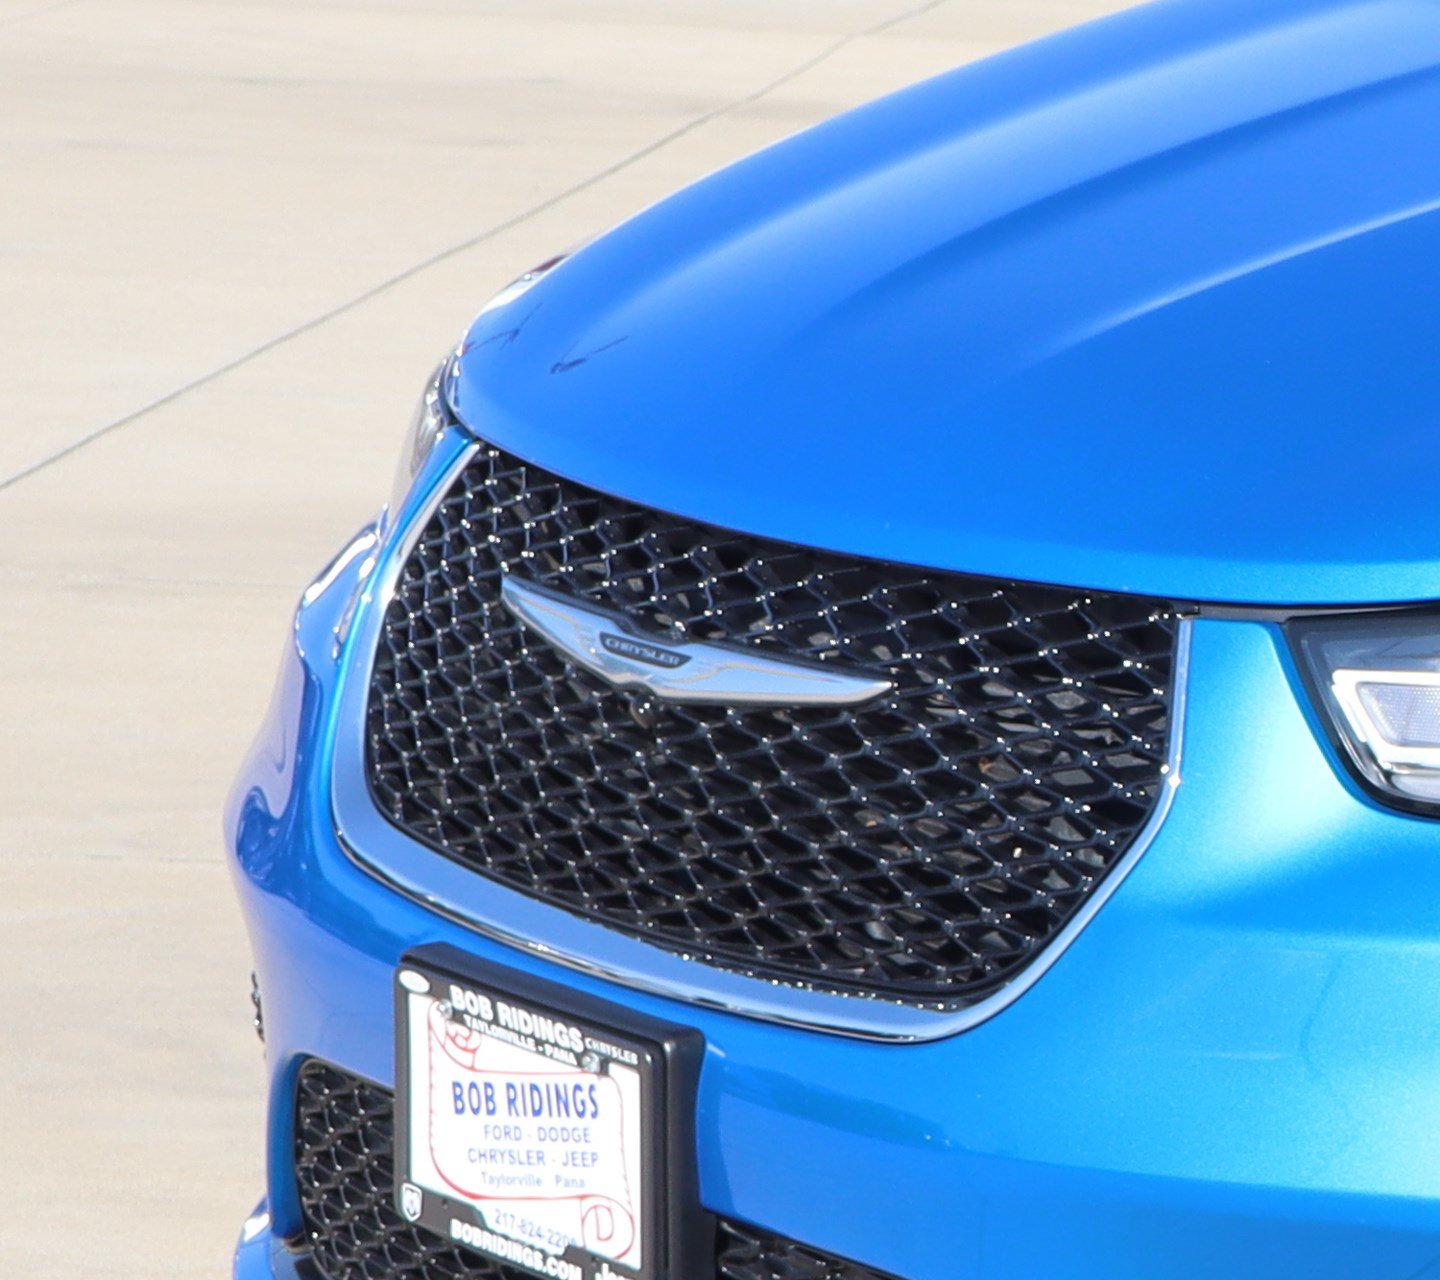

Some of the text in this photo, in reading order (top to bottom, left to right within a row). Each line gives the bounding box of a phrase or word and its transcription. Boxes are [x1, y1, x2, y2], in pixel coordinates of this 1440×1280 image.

[604, 637, 680, 666] CHRYSLER
[450, 984, 585, 1053] BOB RIDINGS
[463, 1014, 537, 1052] TAYLORVILLE
[584, 1037, 639, 1065] CHRYSLER
[451, 1080, 599, 1120] BOB RIDINGS
[483, 1124, 592, 1144] FORD DODGE
[467, 1147, 599, 1168] CHRYSLER JEEP
[480, 1170, 586, 1189] Taylorville Pana
